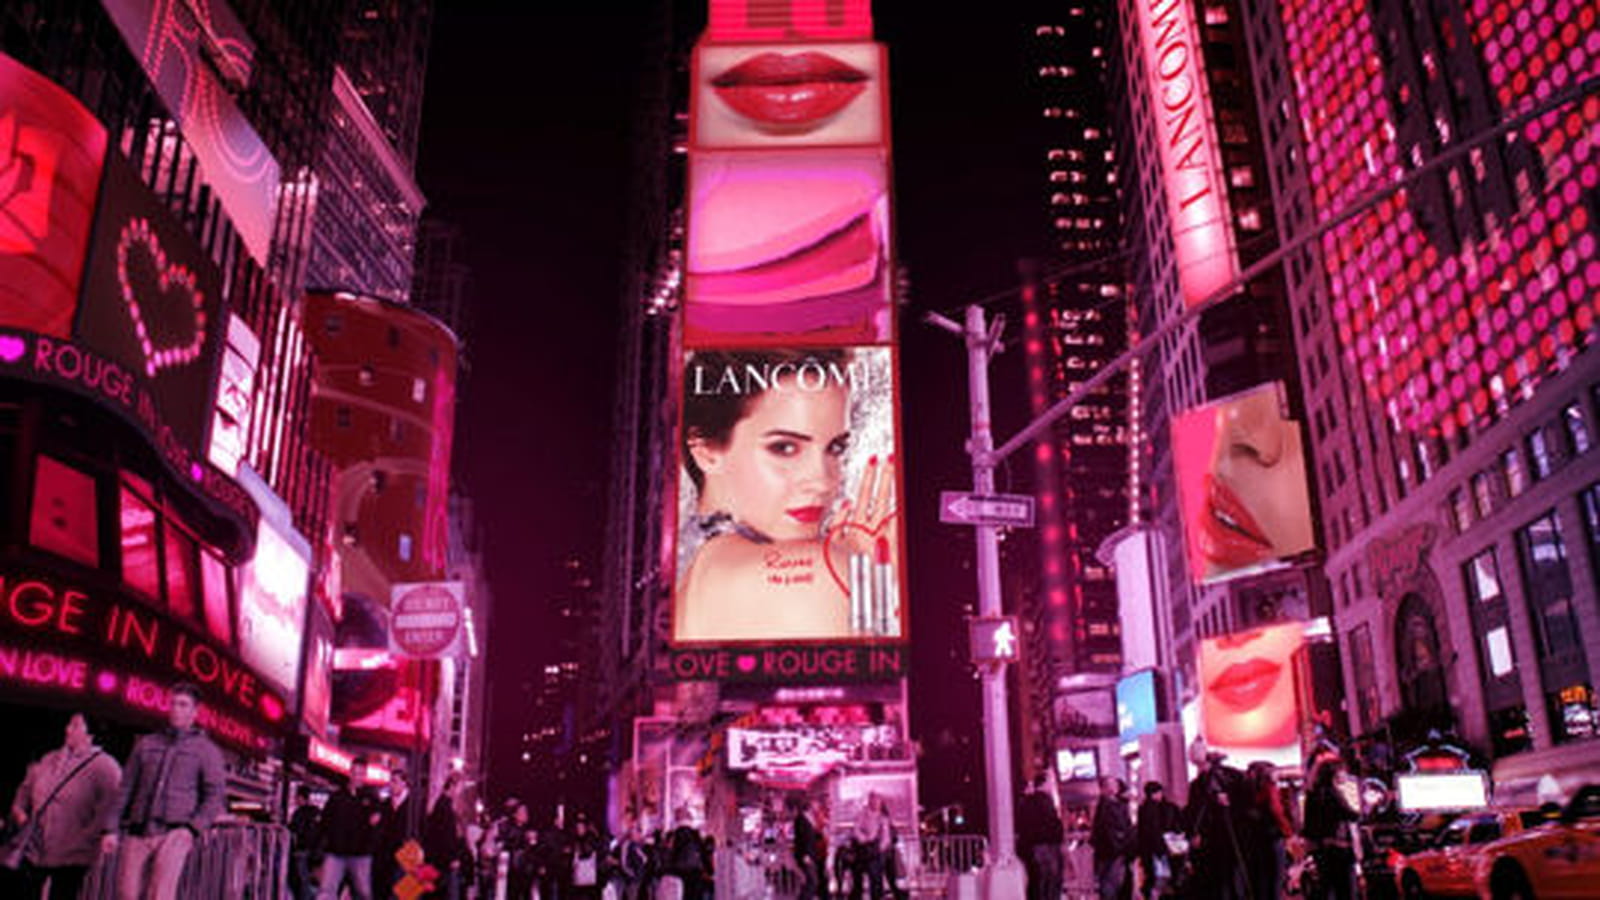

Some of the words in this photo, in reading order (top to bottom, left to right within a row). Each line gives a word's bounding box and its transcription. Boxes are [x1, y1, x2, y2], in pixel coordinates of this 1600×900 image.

[34, 338, 134, 404] ROUGE
[0, 576, 89, 635] GE
[107, 604, 159, 657] IN
[174, 634, 257, 708] LOVE
[763, 650, 856, 676] ROUGE
[869, 648, 900, 672] IN
[22, 650, 88, 689] LOVE
[126, 676, 172, 711] ROU
